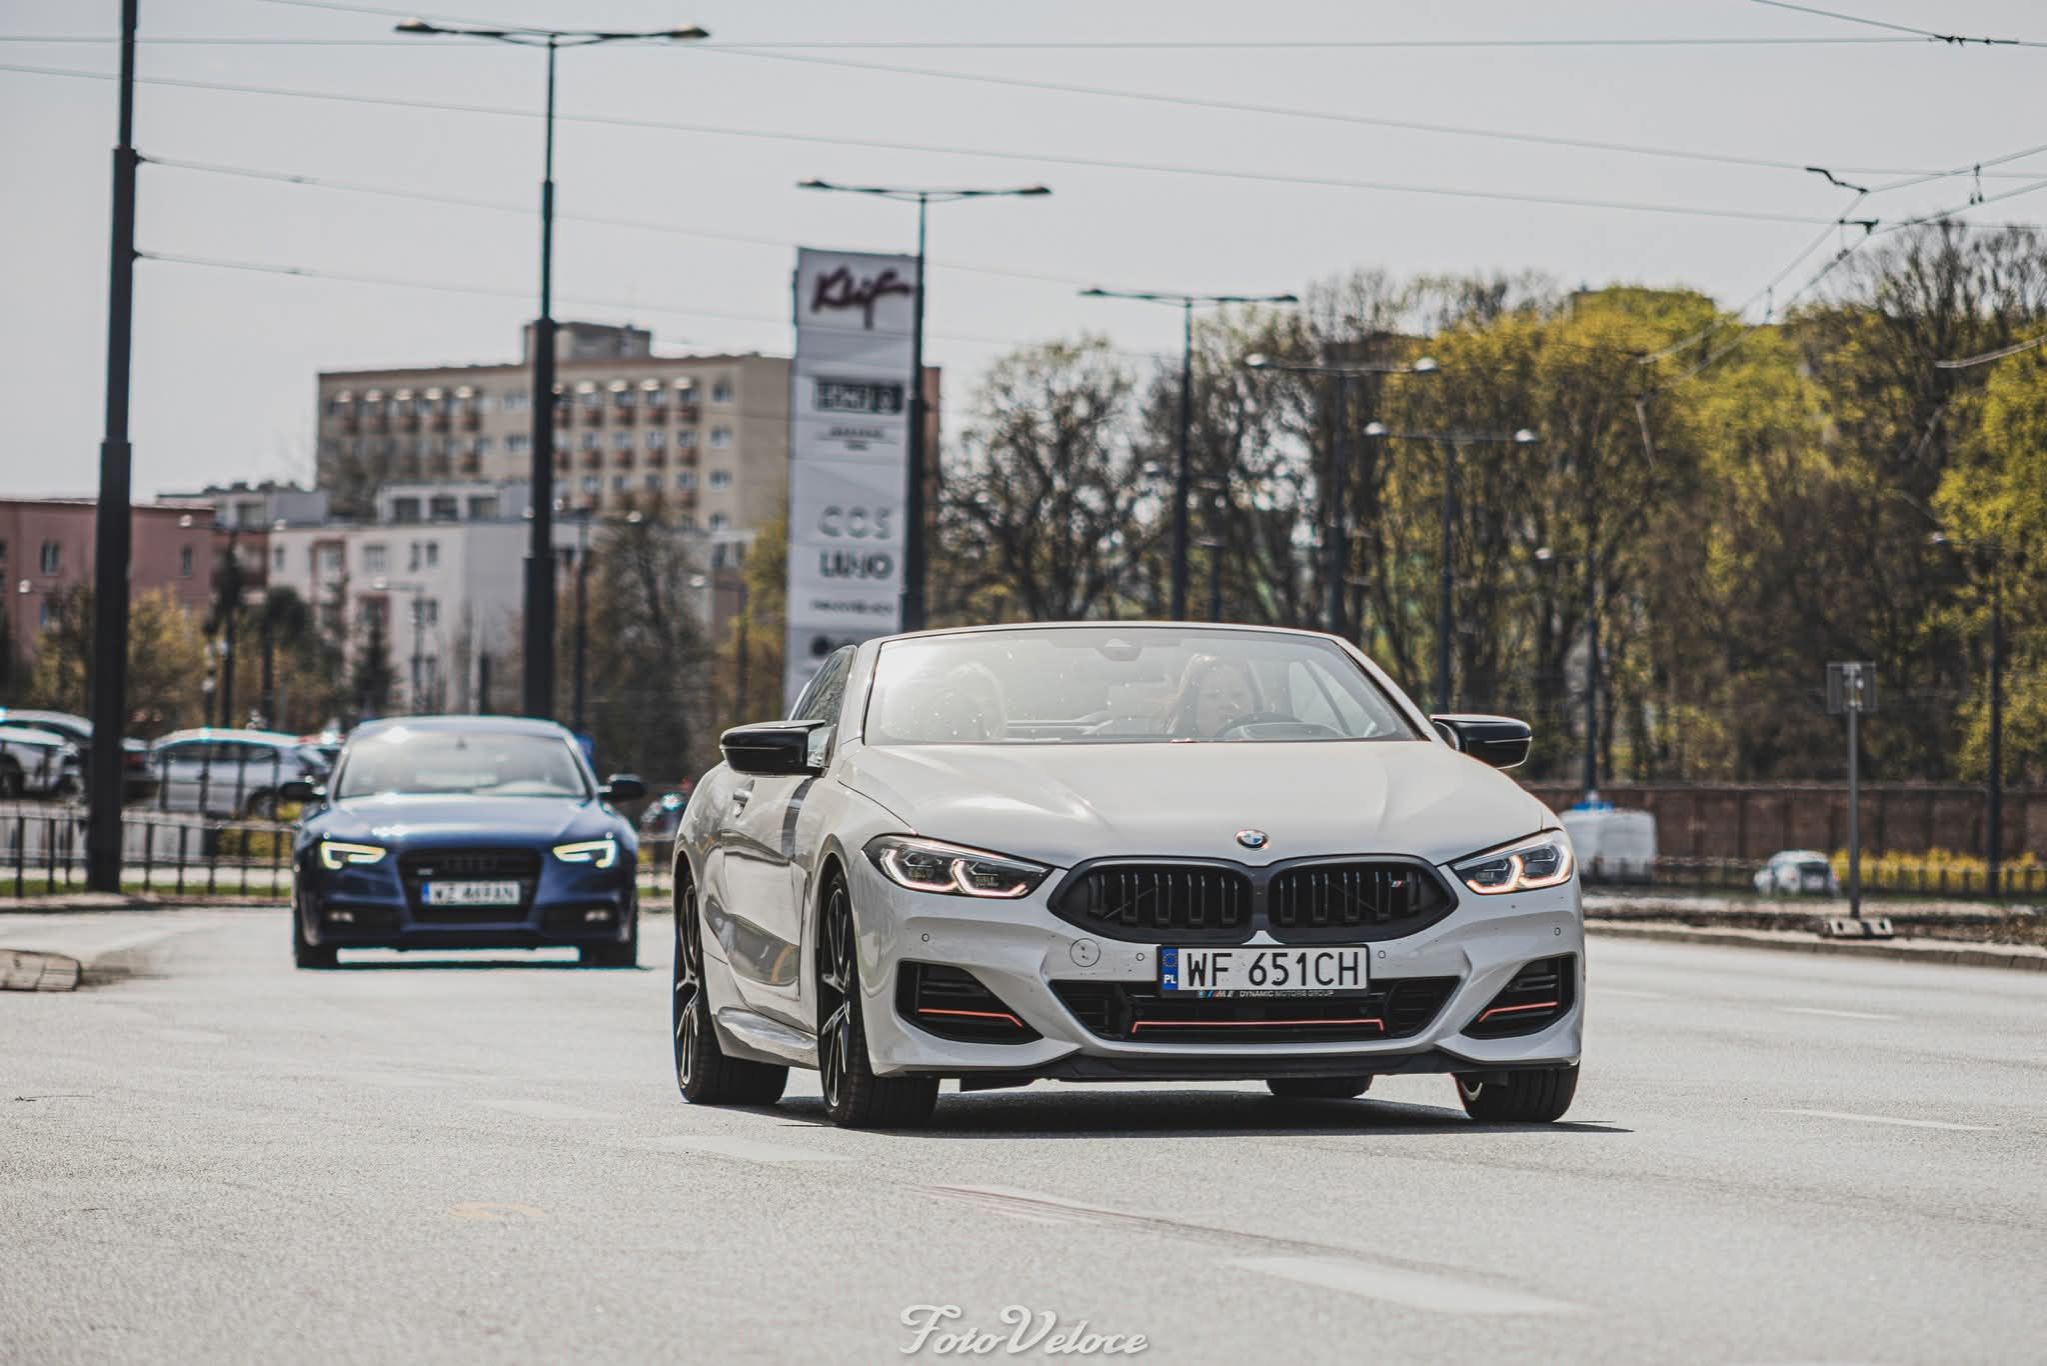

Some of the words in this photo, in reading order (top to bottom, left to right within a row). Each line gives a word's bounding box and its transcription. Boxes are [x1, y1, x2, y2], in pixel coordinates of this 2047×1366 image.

[1187, 952, 1232, 987] WF
[1248, 952, 1358, 987] 651CH
[1163, 974, 1177, 984] PL
[1239, 990, 1274, 998] DYNAMIC
[1275, 990, 1306, 998] MOTORS
[1308, 989, 1334, 997] GROUP
